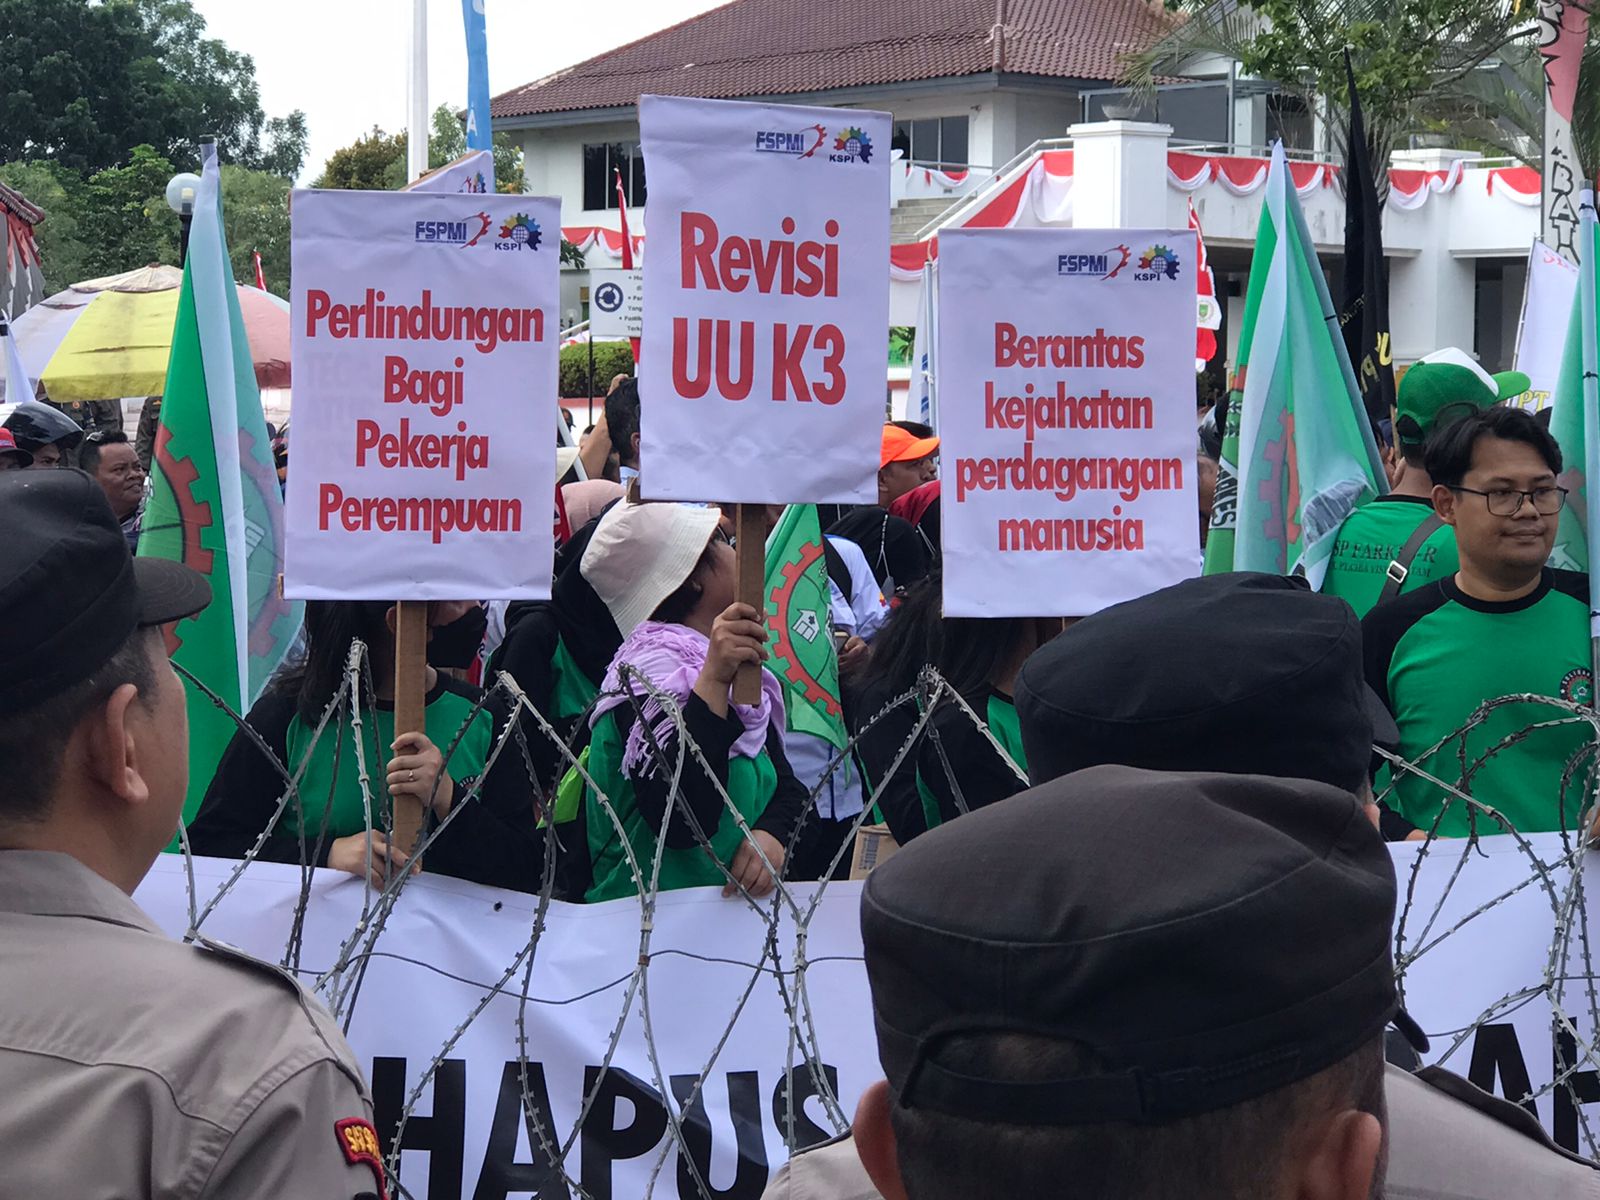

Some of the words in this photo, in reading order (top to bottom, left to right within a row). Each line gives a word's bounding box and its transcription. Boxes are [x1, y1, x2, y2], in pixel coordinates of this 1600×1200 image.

[755, 131, 804, 151] FSPMI
[829, 154, 855, 163] KSPI
[415, 221, 467, 241] FSPMI
[494, 242, 522, 251] KSPI
[681, 212, 839, 297] Revisi
[1058, 255, 1108, 272] FSPMI
[1134, 273, 1160, 281] KSPI
[306, 289, 544, 353] Perlindungan
[995, 323, 1144, 369] Berantas
[384, 357, 464, 417] Bagi
[672, 317, 754, 401] UU
[772, 323, 846, 405] K3
[985, 381, 1153, 441] kejahatan
[356, 417, 488, 481] Pekerja
[956, 442, 1183, 502] perdagangan
[319, 483, 521, 544] Perempuan
[999, 506, 1144, 551] manusia
[372, 1056, 838, 1200] HAPUS
